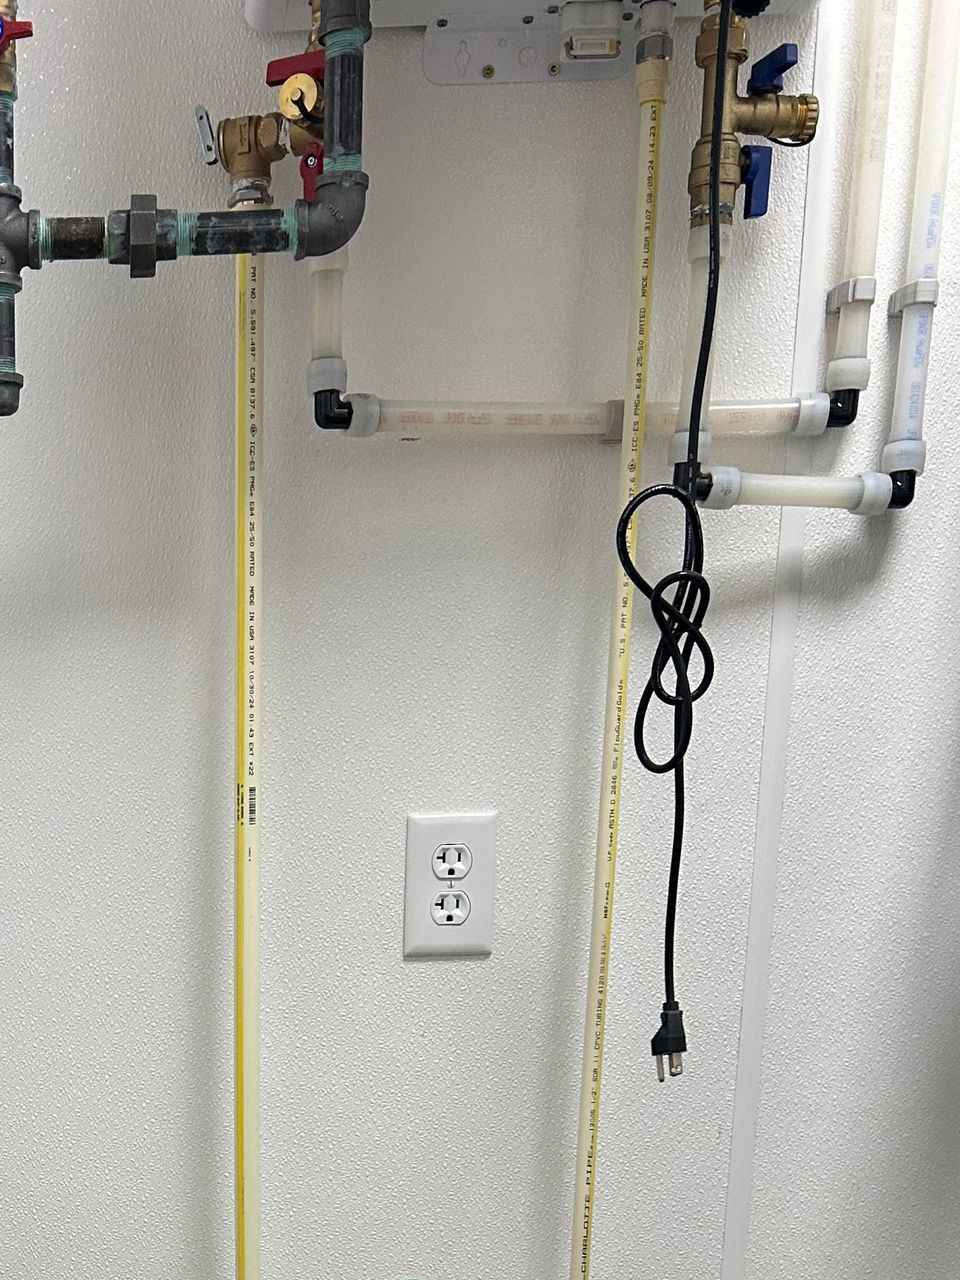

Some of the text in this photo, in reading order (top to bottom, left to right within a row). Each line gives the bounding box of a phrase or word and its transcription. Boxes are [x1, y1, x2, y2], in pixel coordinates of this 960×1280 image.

[644, 208, 652, 231] 3107
[642, 257, 649, 268] IN
[640, 274, 648, 297] MADE
[638, 307, 646, 334] RATED
[631, 420, 639, 452] ICC-ES
[248, 611, 255, 622] IN
[597, 974, 605, 994] 4120
[596, 998, 604, 1026] TUBING
[594, 1031, 602, 1050] CPVC
[580, 1193, 590, 1273] CHARLOTTE
